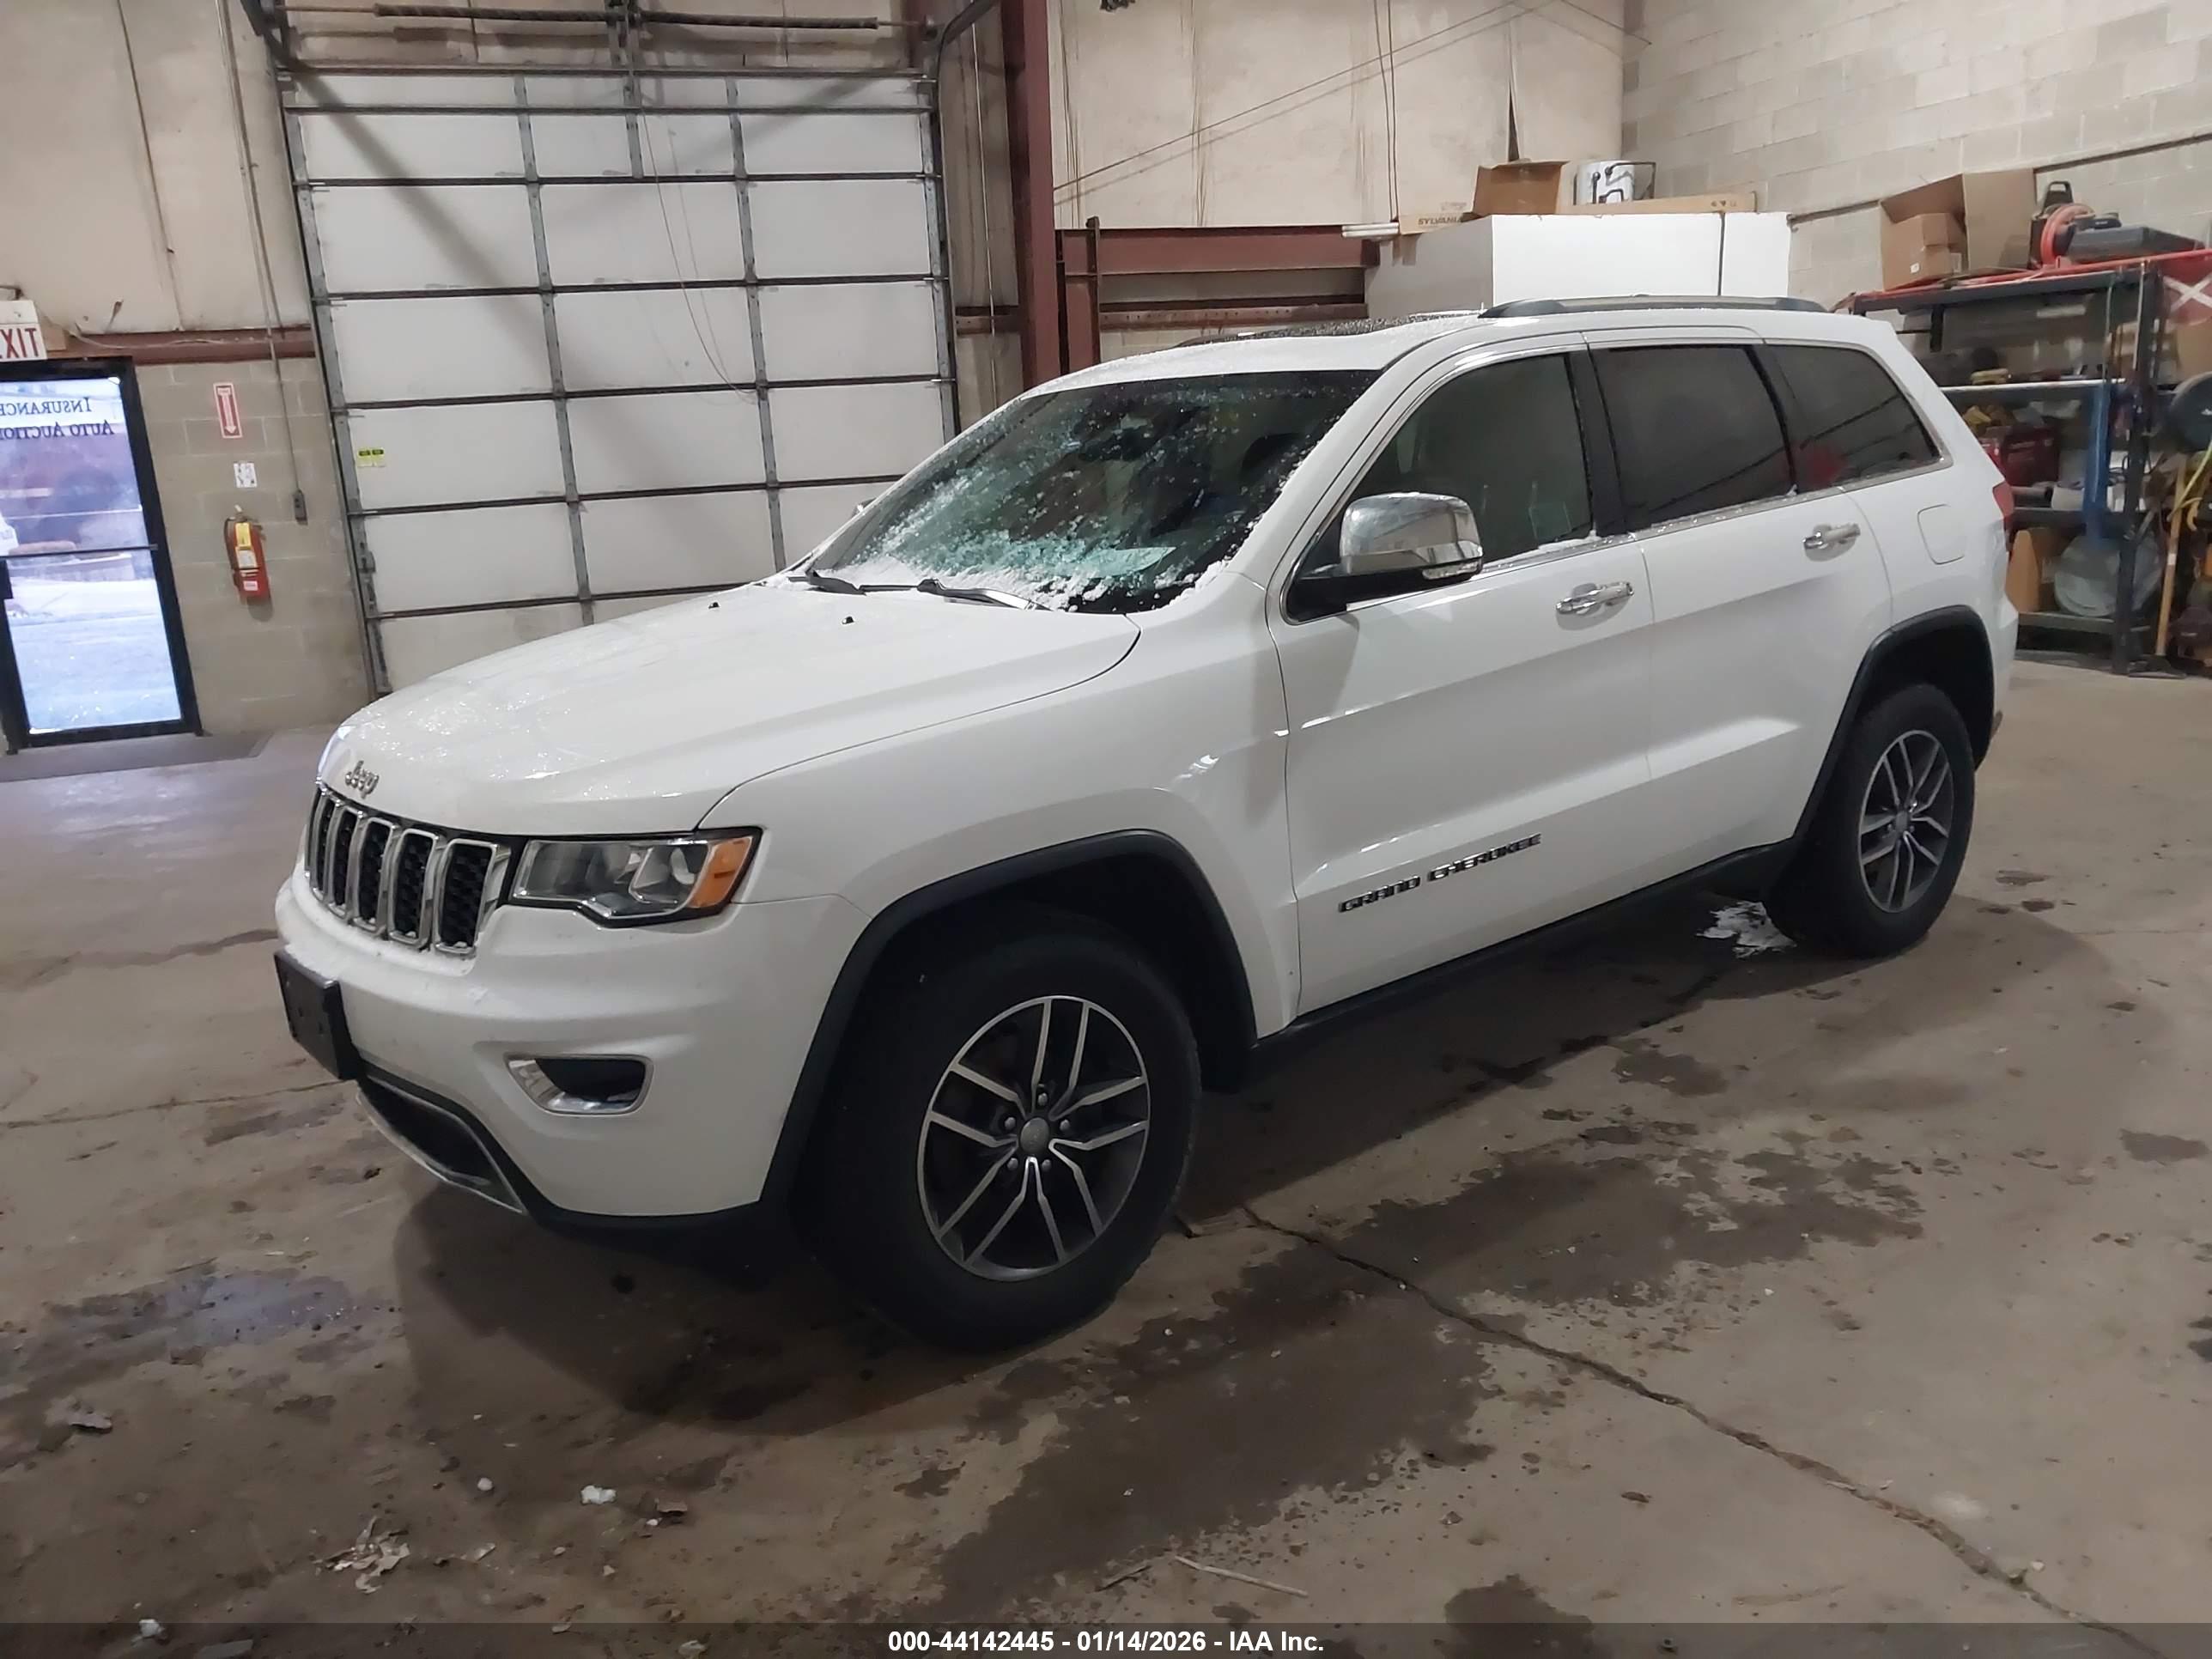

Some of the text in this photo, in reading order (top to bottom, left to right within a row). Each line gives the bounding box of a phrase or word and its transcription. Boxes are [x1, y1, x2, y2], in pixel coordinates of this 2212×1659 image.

[0, 328, 39, 359] XIT
[344, 760, 380, 799] Jeep
[1339, 832, 1541, 913] GRAND CHEROKEE
